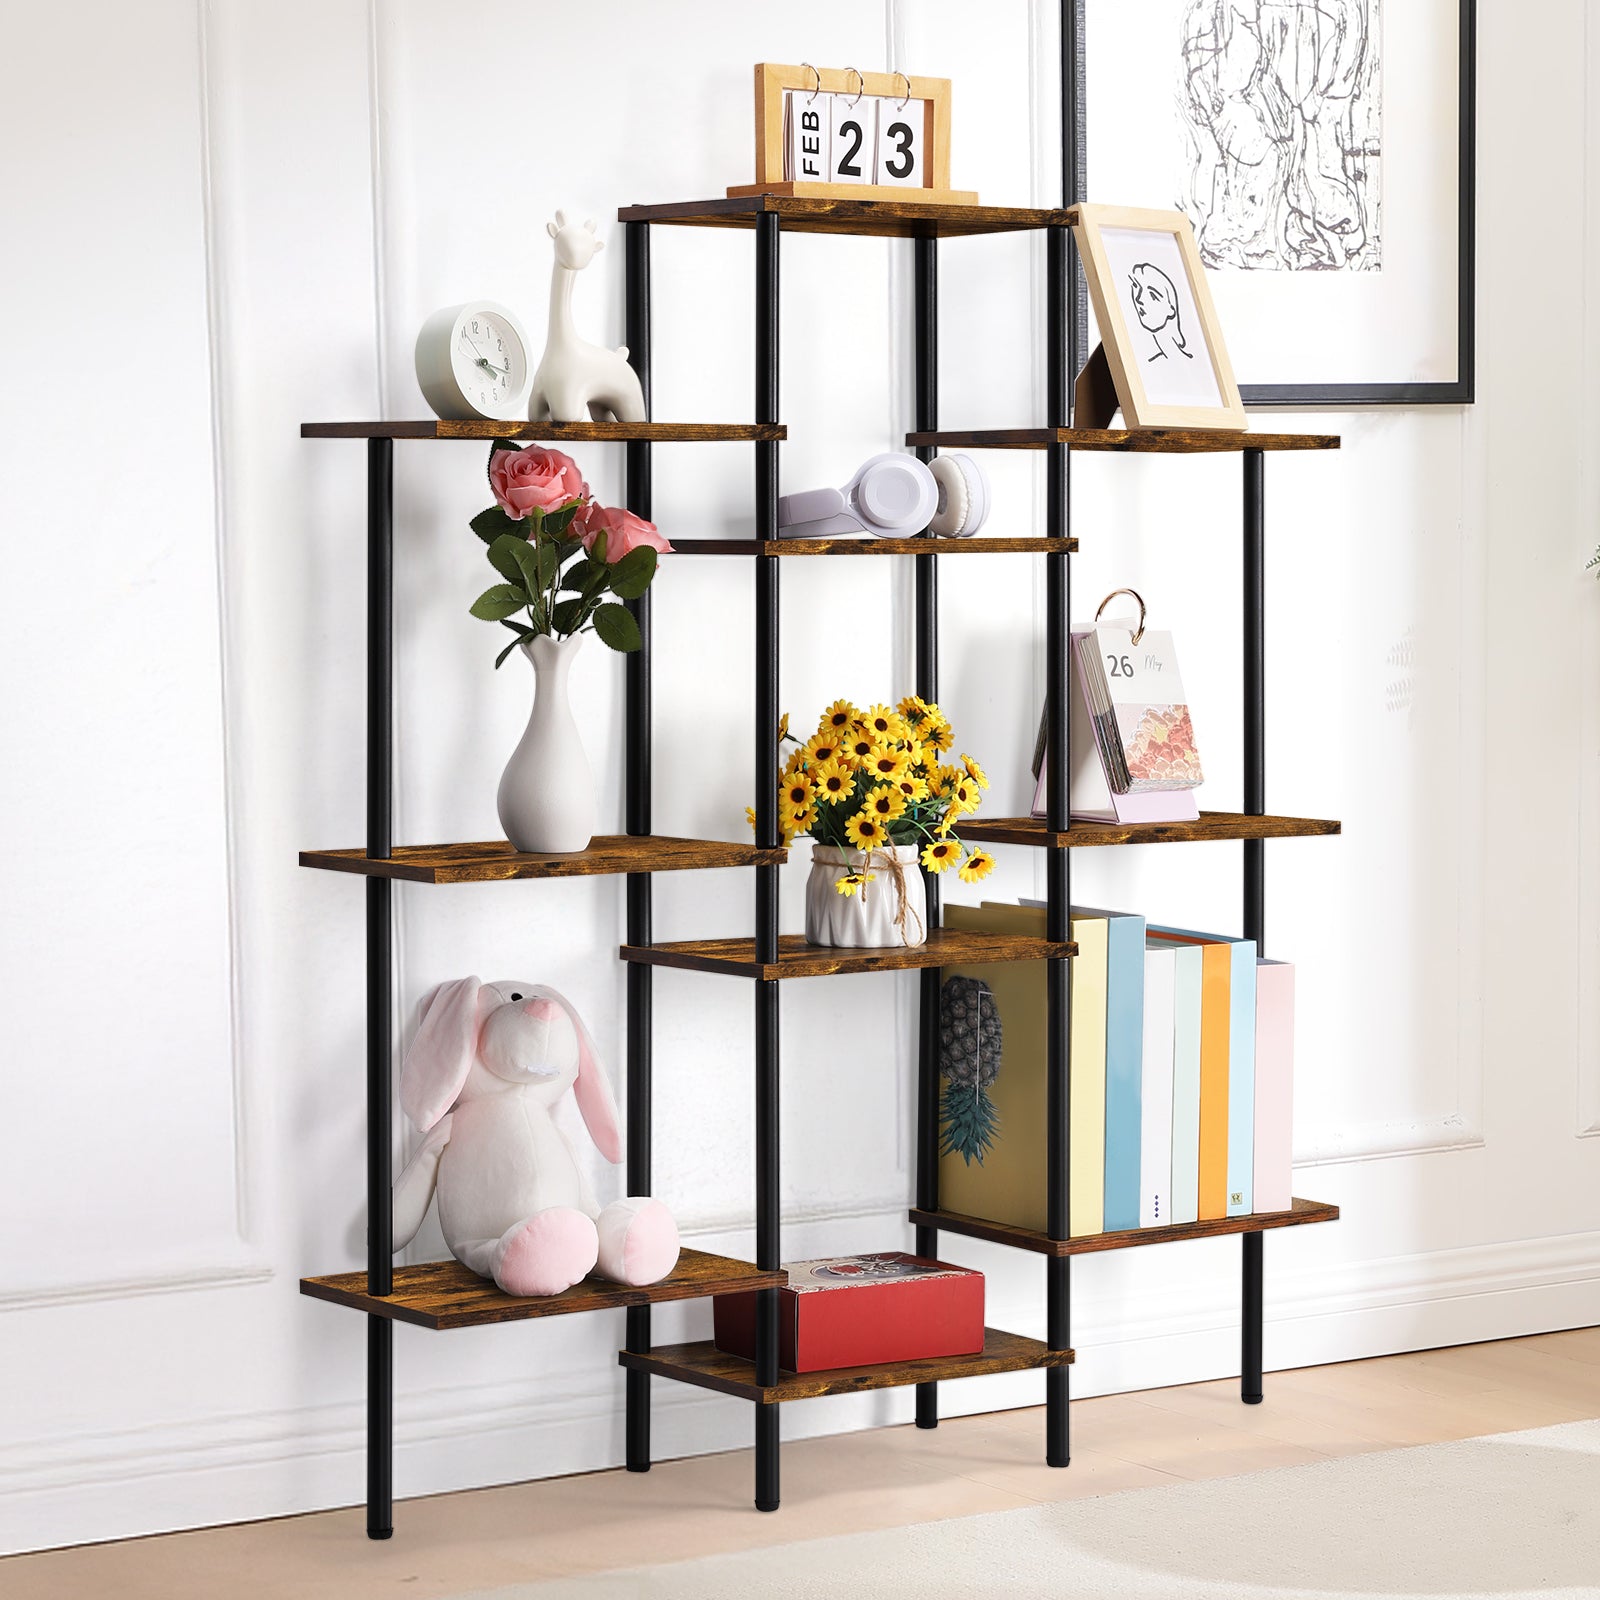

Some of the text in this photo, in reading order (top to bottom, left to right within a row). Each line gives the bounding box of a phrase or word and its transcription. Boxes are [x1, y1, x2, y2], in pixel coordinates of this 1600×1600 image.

[802, 111, 914, 178] FEB 2 3
[471, 321, 479, 334] 12
[486, 326, 491, 339] 1
[497, 338, 502, 352] 2
[504, 357, 509, 371] 3
[501, 375, 506, 389] 4
[493, 387, 498, 401] 5
[1106, 654, 1134, 678] 26
